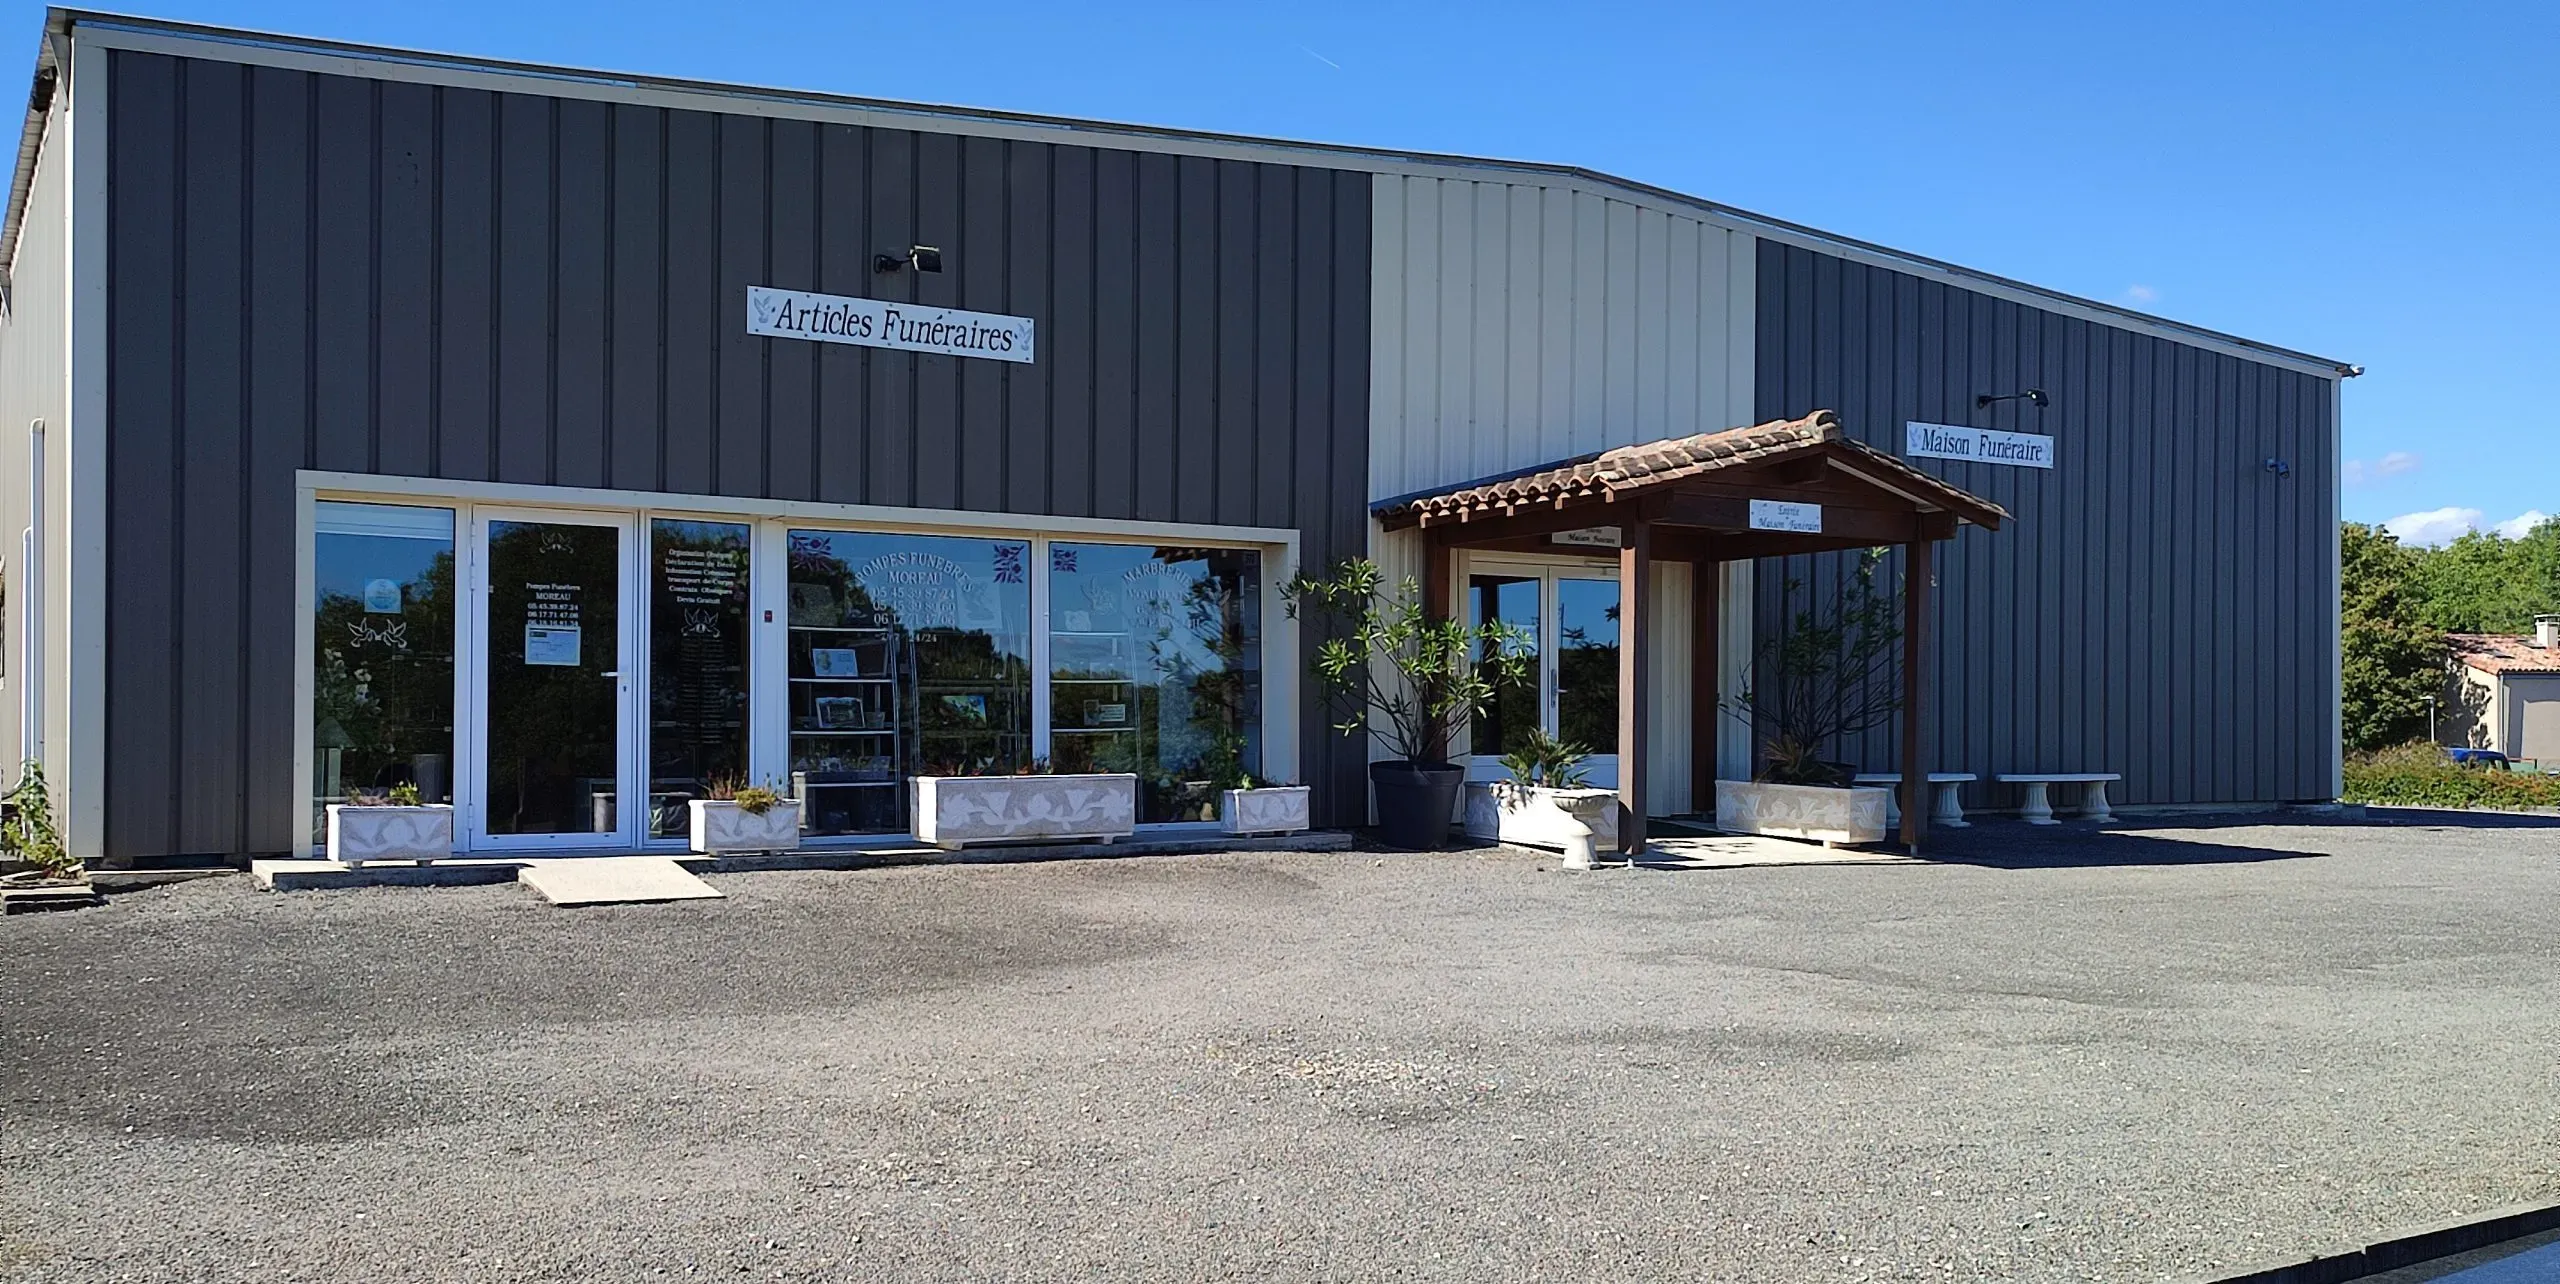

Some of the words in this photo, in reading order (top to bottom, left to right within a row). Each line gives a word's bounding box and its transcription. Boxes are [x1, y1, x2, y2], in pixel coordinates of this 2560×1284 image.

[774, 298, 873, 338] Articles
[881, 310, 1013, 352] Funéraires
[1921, 428, 1970, 455] Maison
[1978, 434, 2043, 461] Funéraire
[855, 552, 907, 584] POMPES
[888, 571, 943, 586] MOREAU
[536, 592, 571, 600] MOREAU
[873, 600, 887, 611] 05
[873, 613, 889, 625] 06
